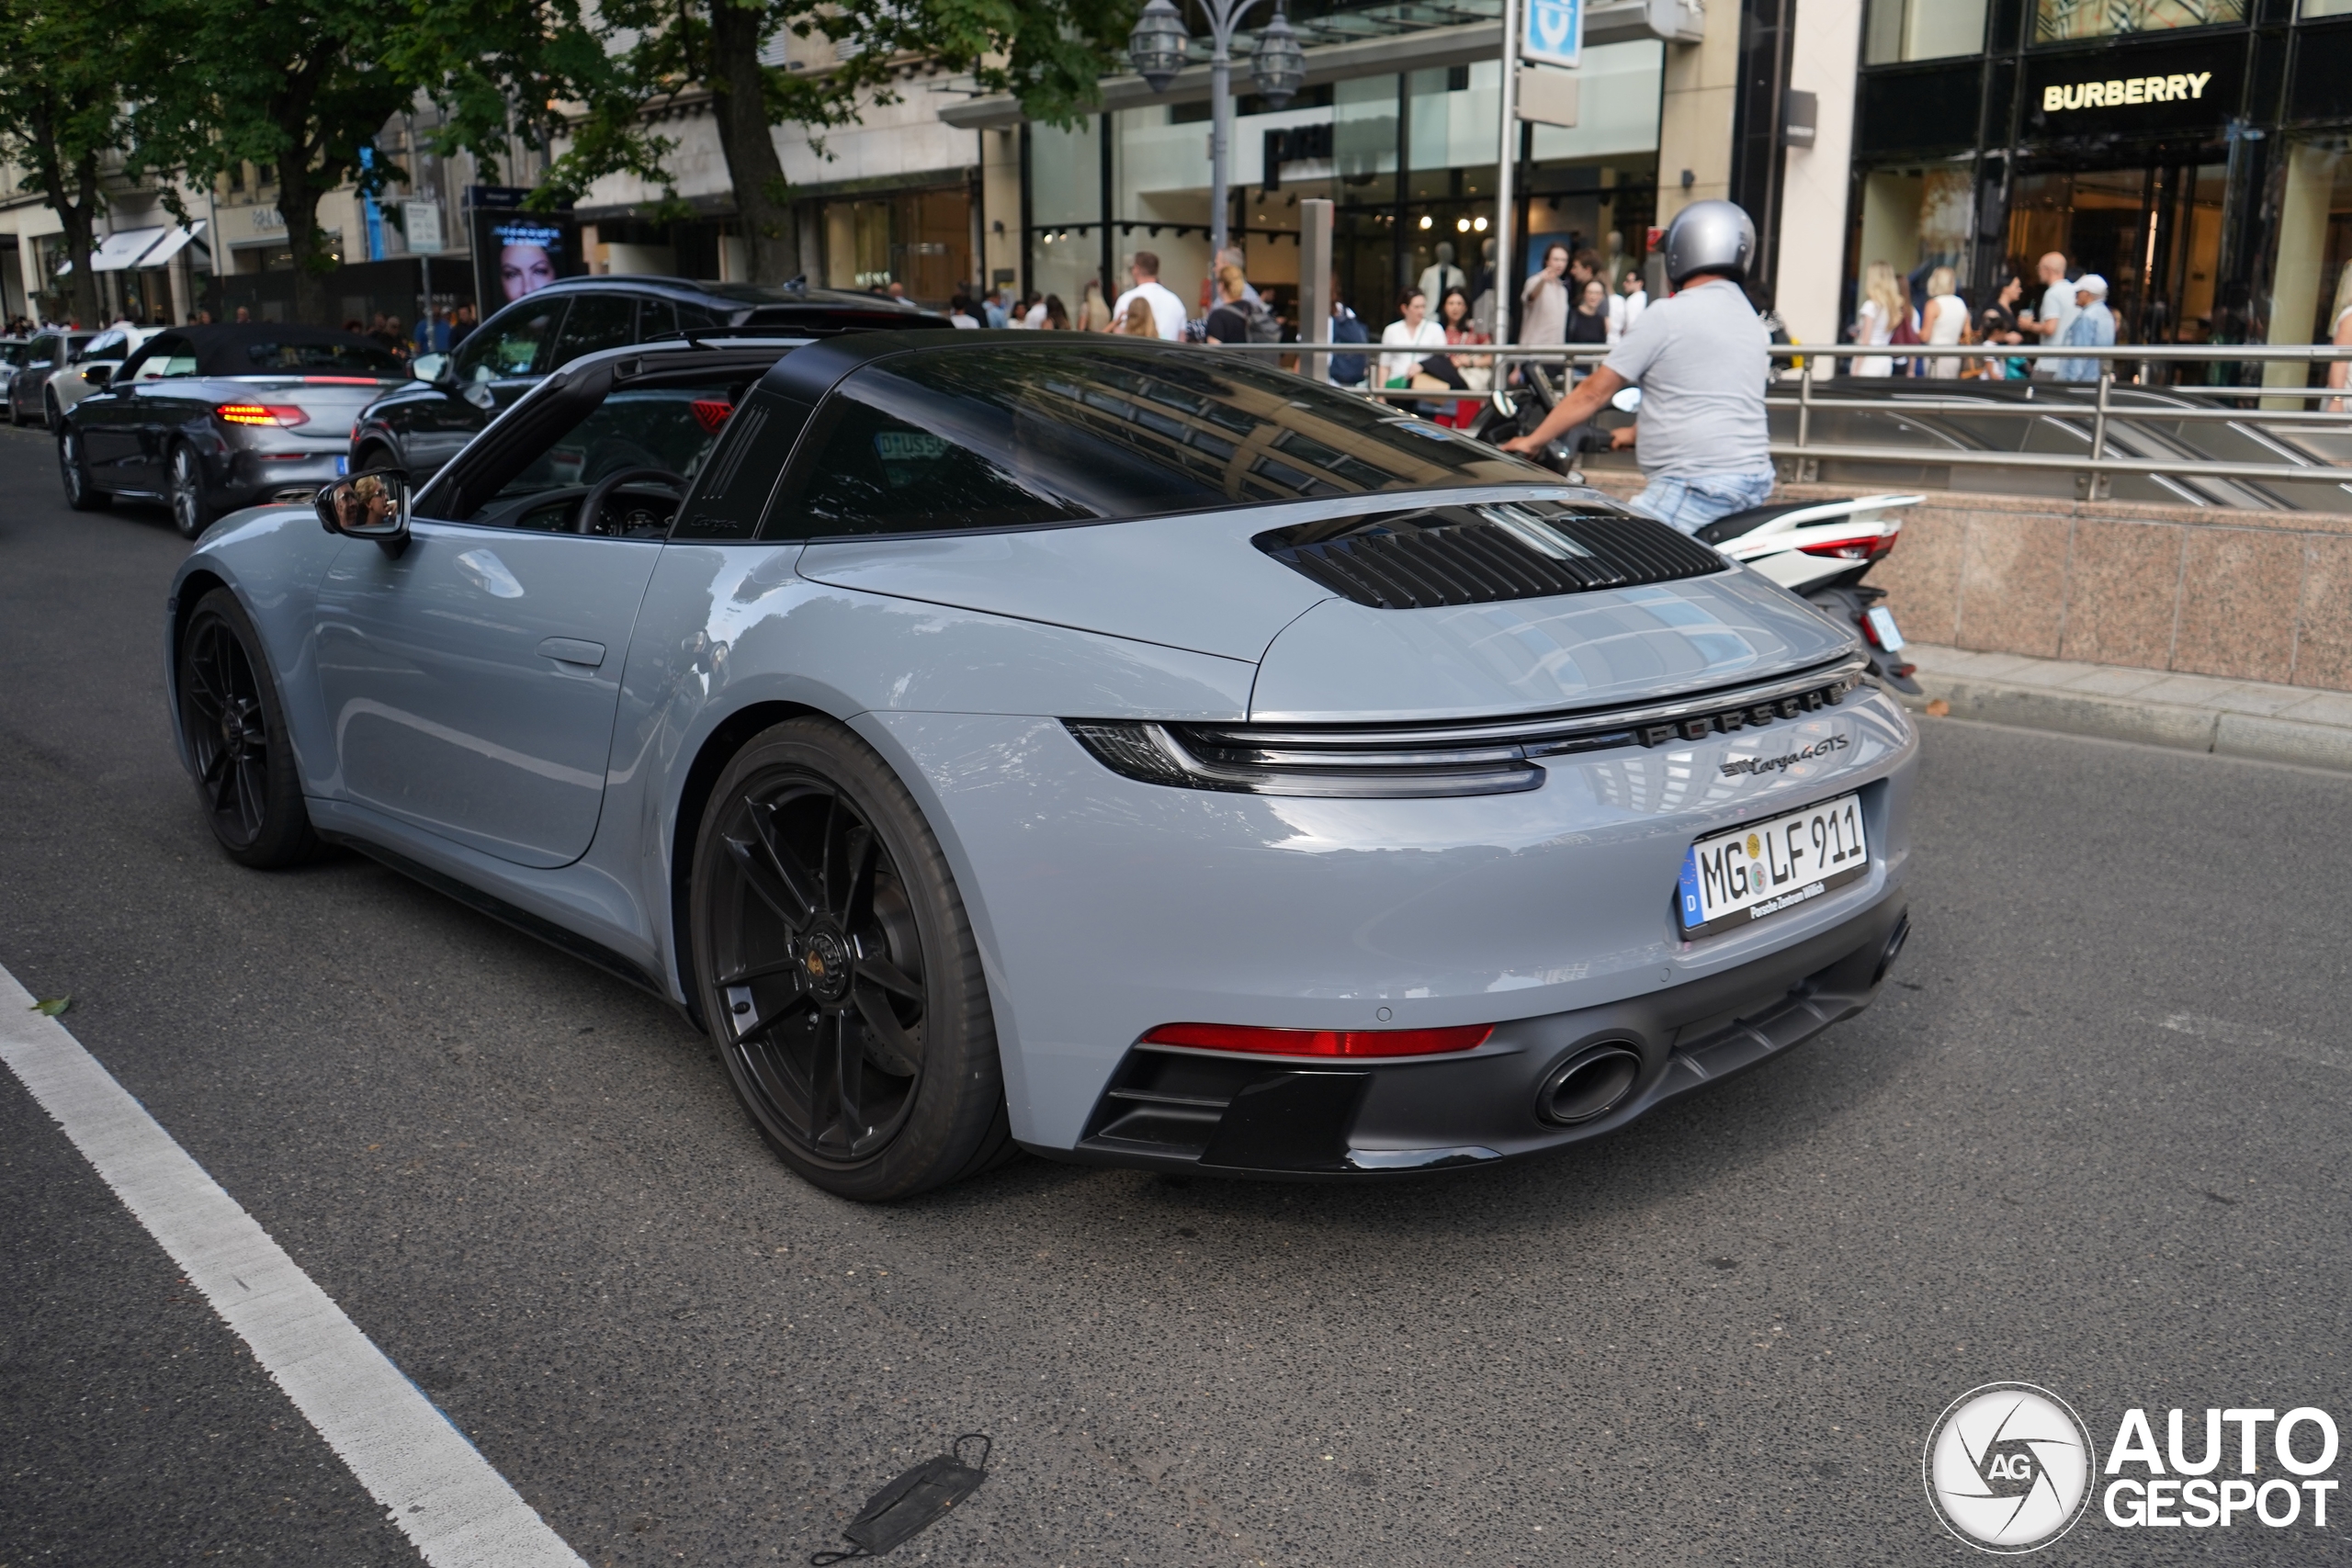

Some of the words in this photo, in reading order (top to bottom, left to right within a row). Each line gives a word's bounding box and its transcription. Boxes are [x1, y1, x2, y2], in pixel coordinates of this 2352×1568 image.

[2042, 71, 2213, 112] BURBERRY
[1639, 683, 1843, 749] PORSCHE
[1814, 734, 1850, 756] GTS
[1686, 894, 1697, 912] D
[1701, 841, 1749, 908] MG
[1766, 821, 1804, 886] LF
[1812, 805, 1861, 869] 911
[1749, 900, 1779, 919] Porsche
[1776, 891, 1805, 909] Zentrum
